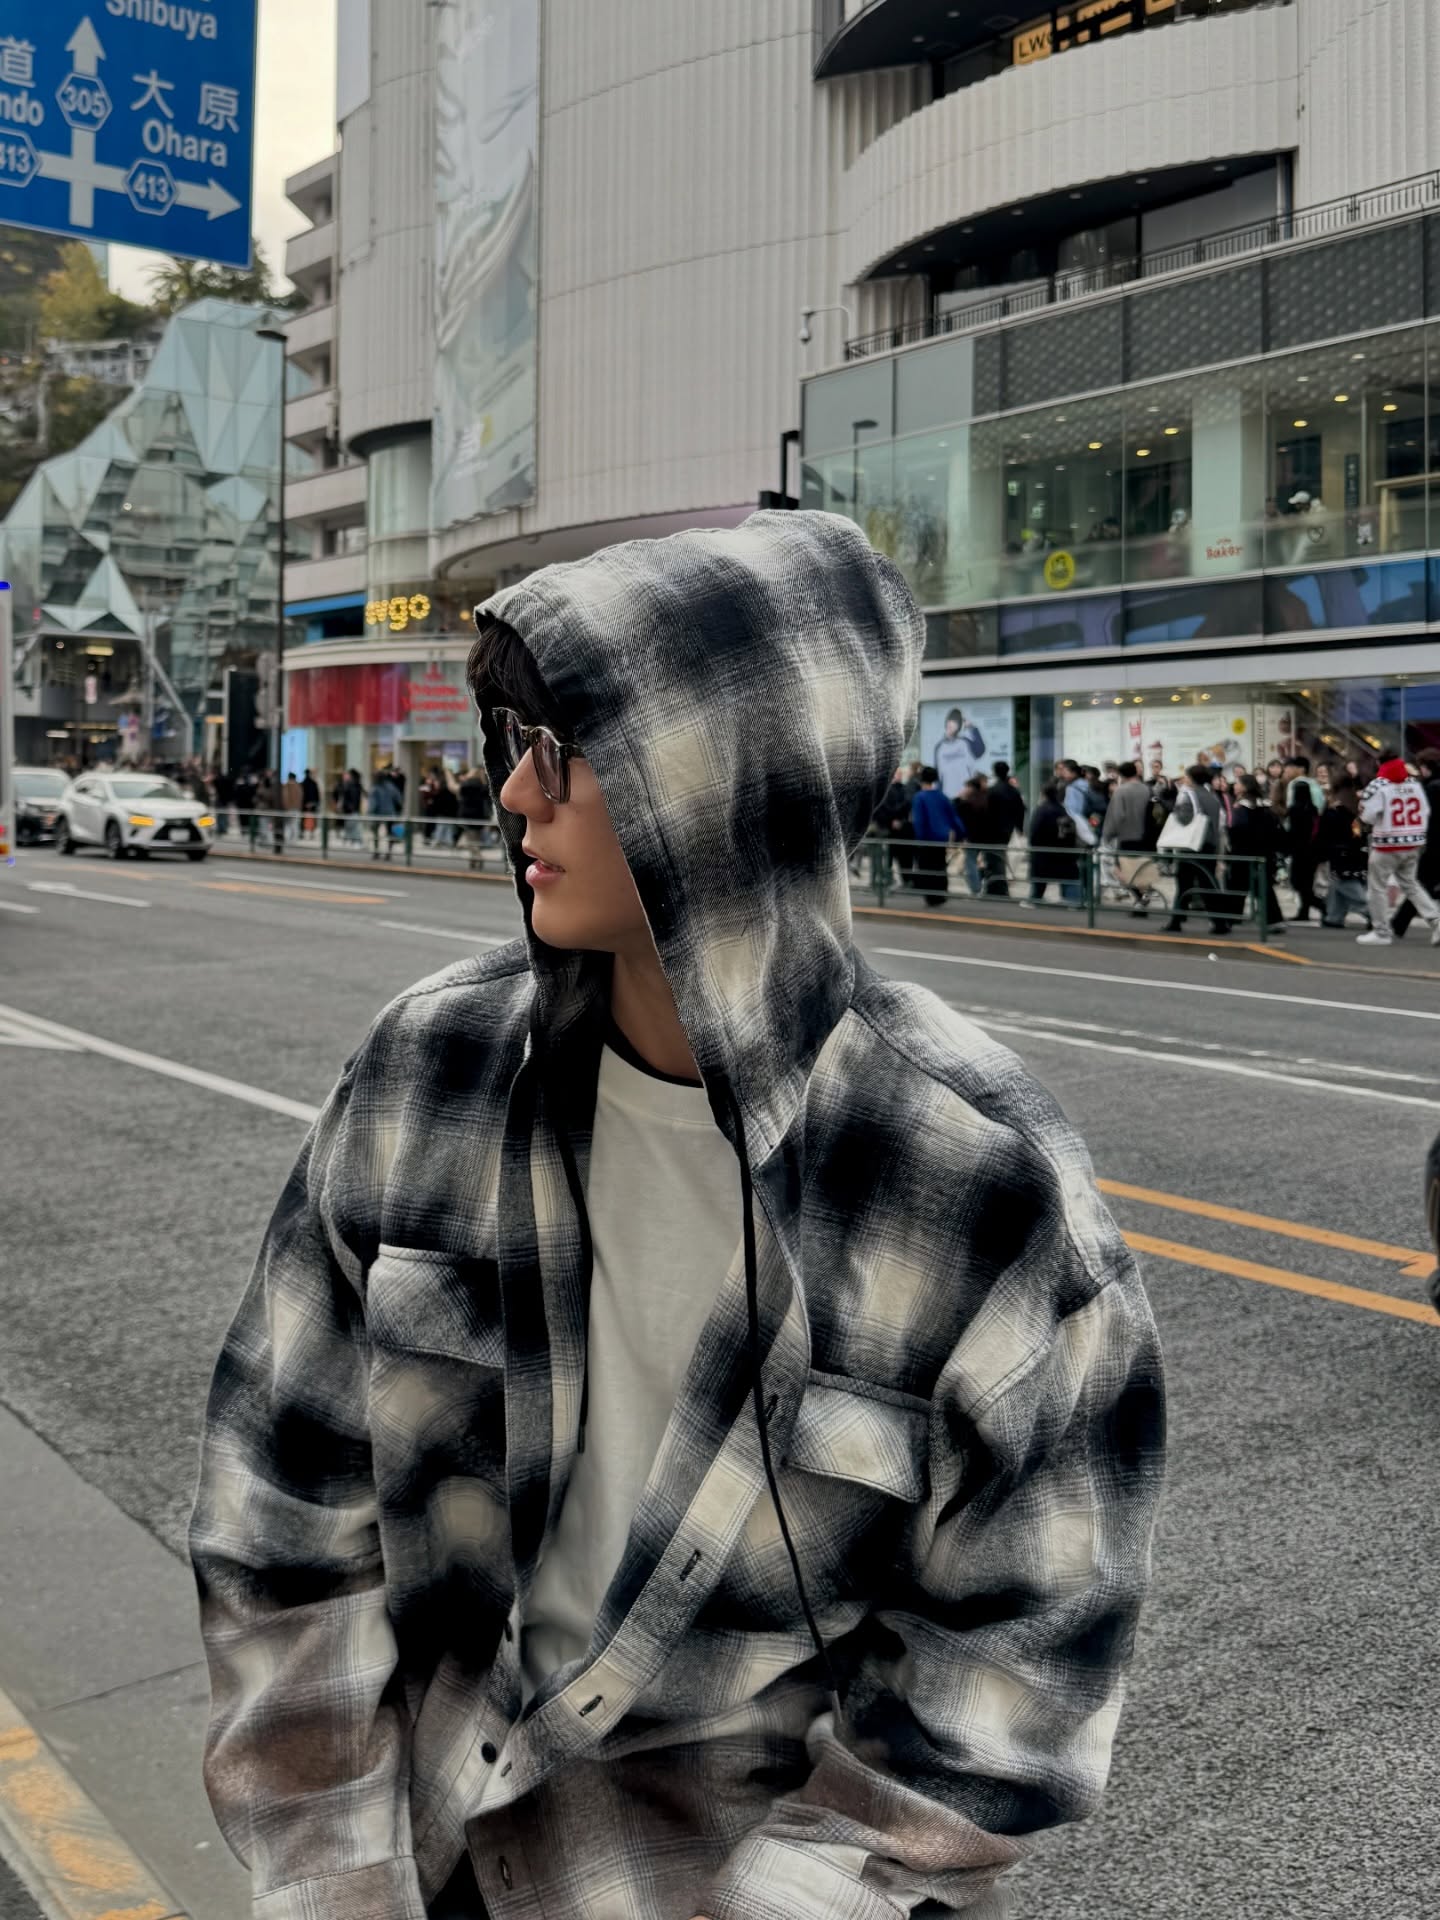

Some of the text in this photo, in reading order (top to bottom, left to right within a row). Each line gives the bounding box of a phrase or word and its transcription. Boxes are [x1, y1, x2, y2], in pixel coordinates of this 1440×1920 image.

[62, 84, 106, 118] 305
[130, 70, 239, 133] 大原
[142, 118, 228, 168] Ohara
[132, 171, 170, 203] 413
[1390, 796, 1422, 827] 22
